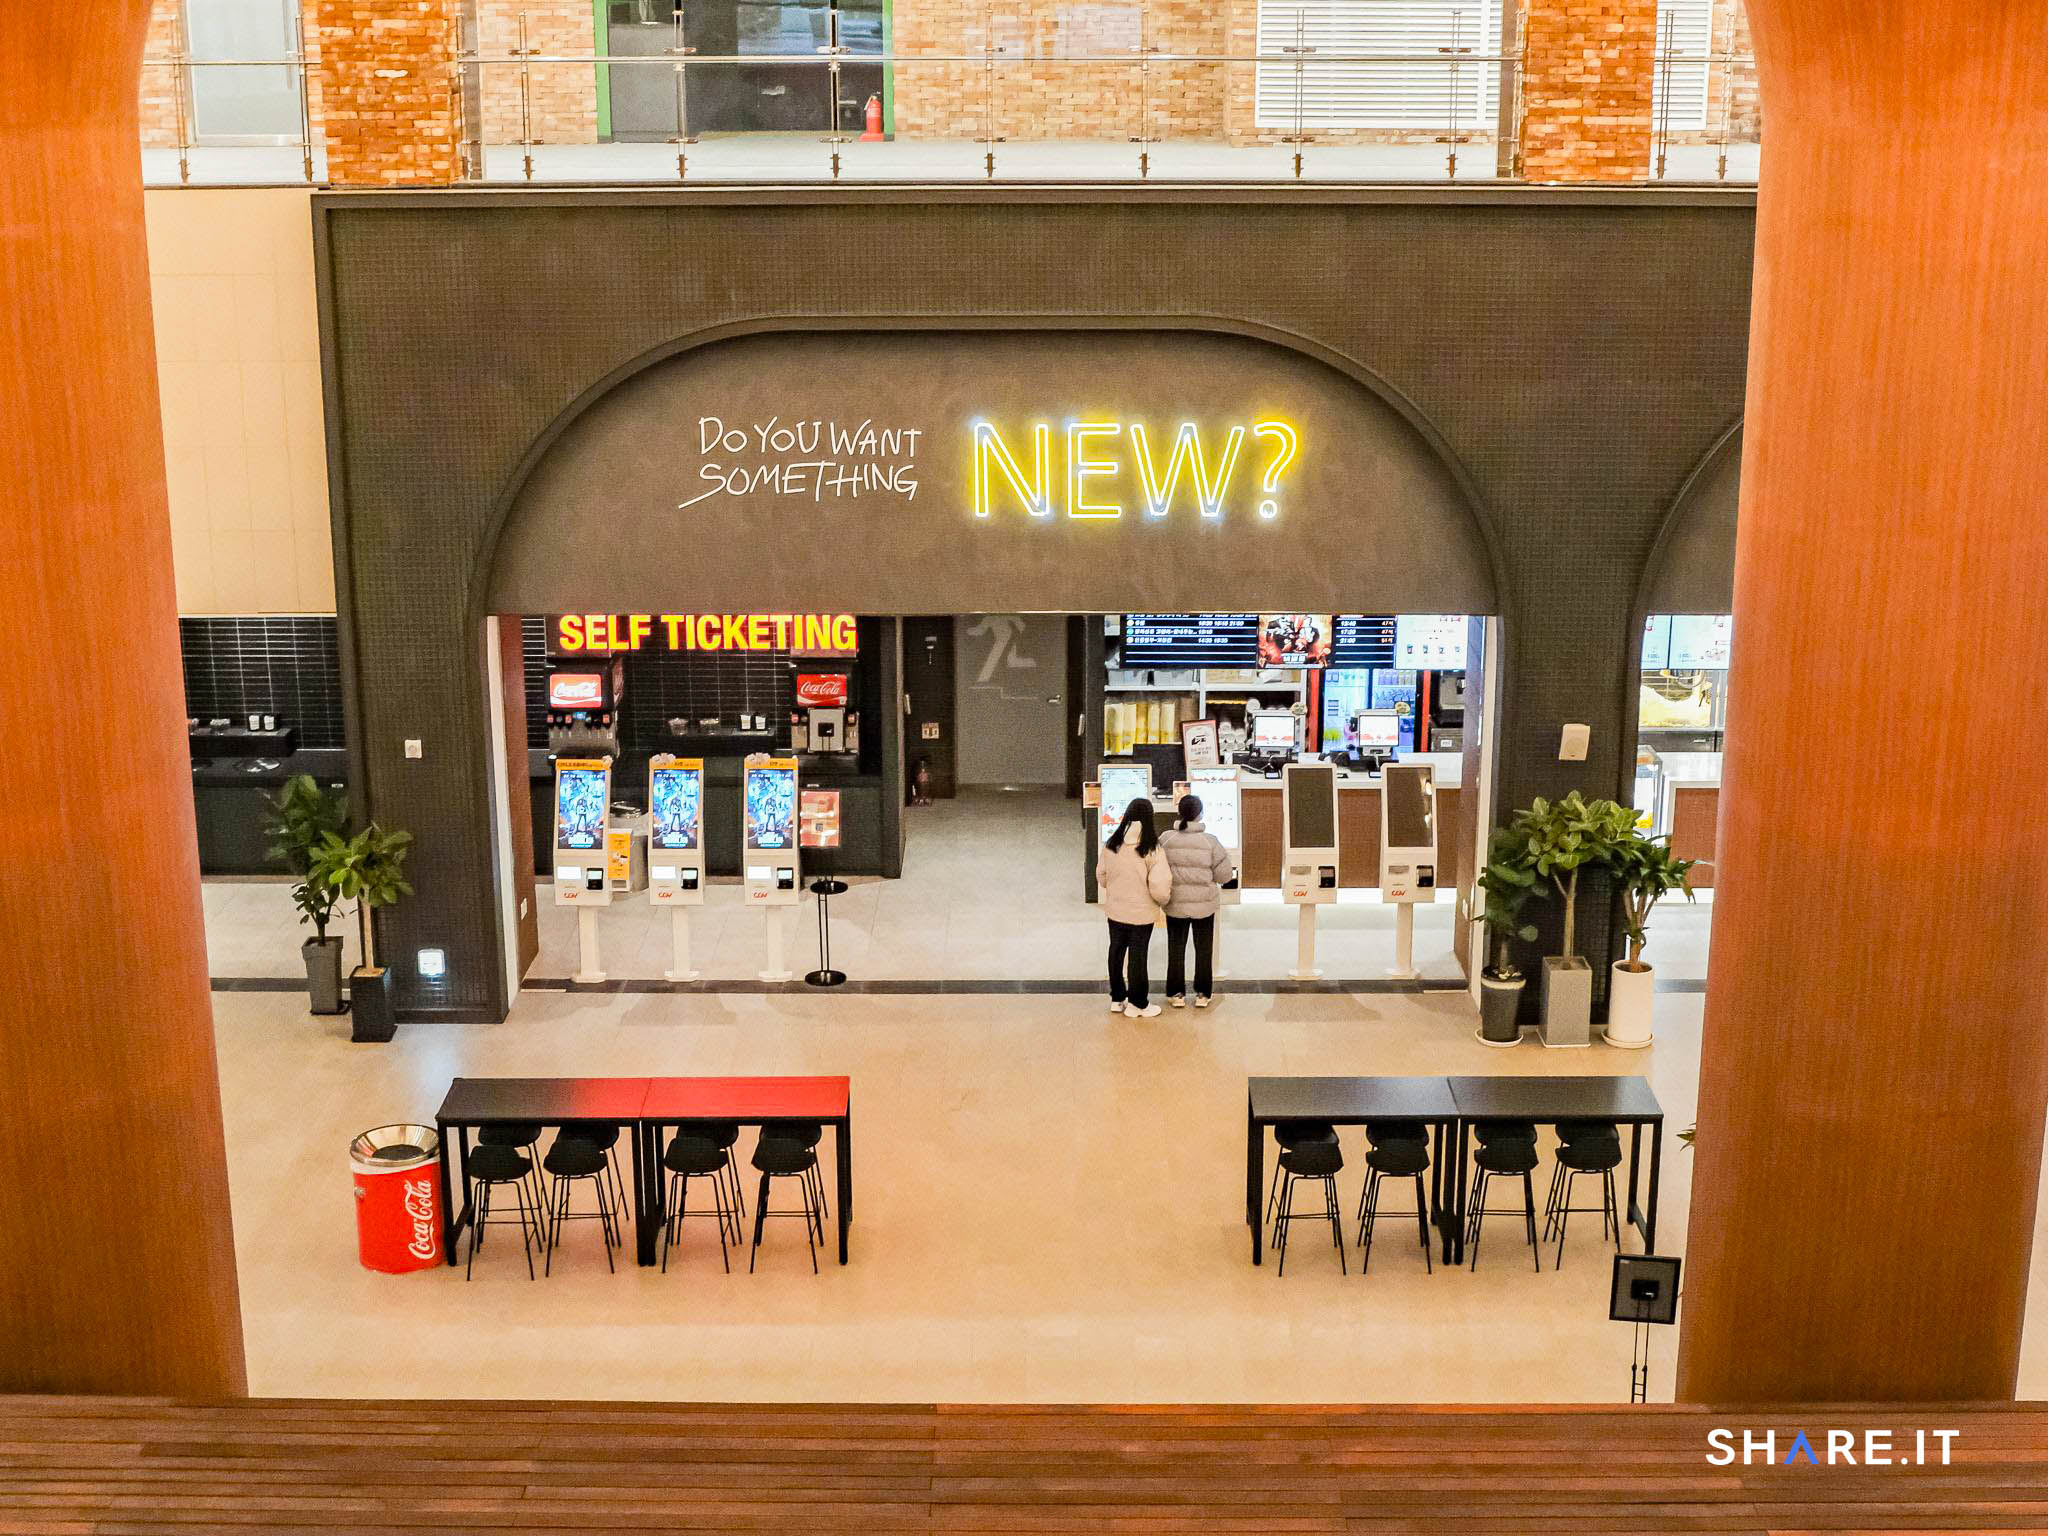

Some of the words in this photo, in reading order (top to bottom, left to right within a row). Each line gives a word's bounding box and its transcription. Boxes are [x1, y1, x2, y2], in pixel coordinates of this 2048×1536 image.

[698, 416, 749, 455] DO
[754, 416, 822, 455] YOU
[829, 418, 922, 457] WANT
[678, 460, 920, 510] SOMETHING
[967, 415, 1297, 523] NEW?
[558, 614, 652, 652] SELF
[660, 614, 858, 652] TICKETING
